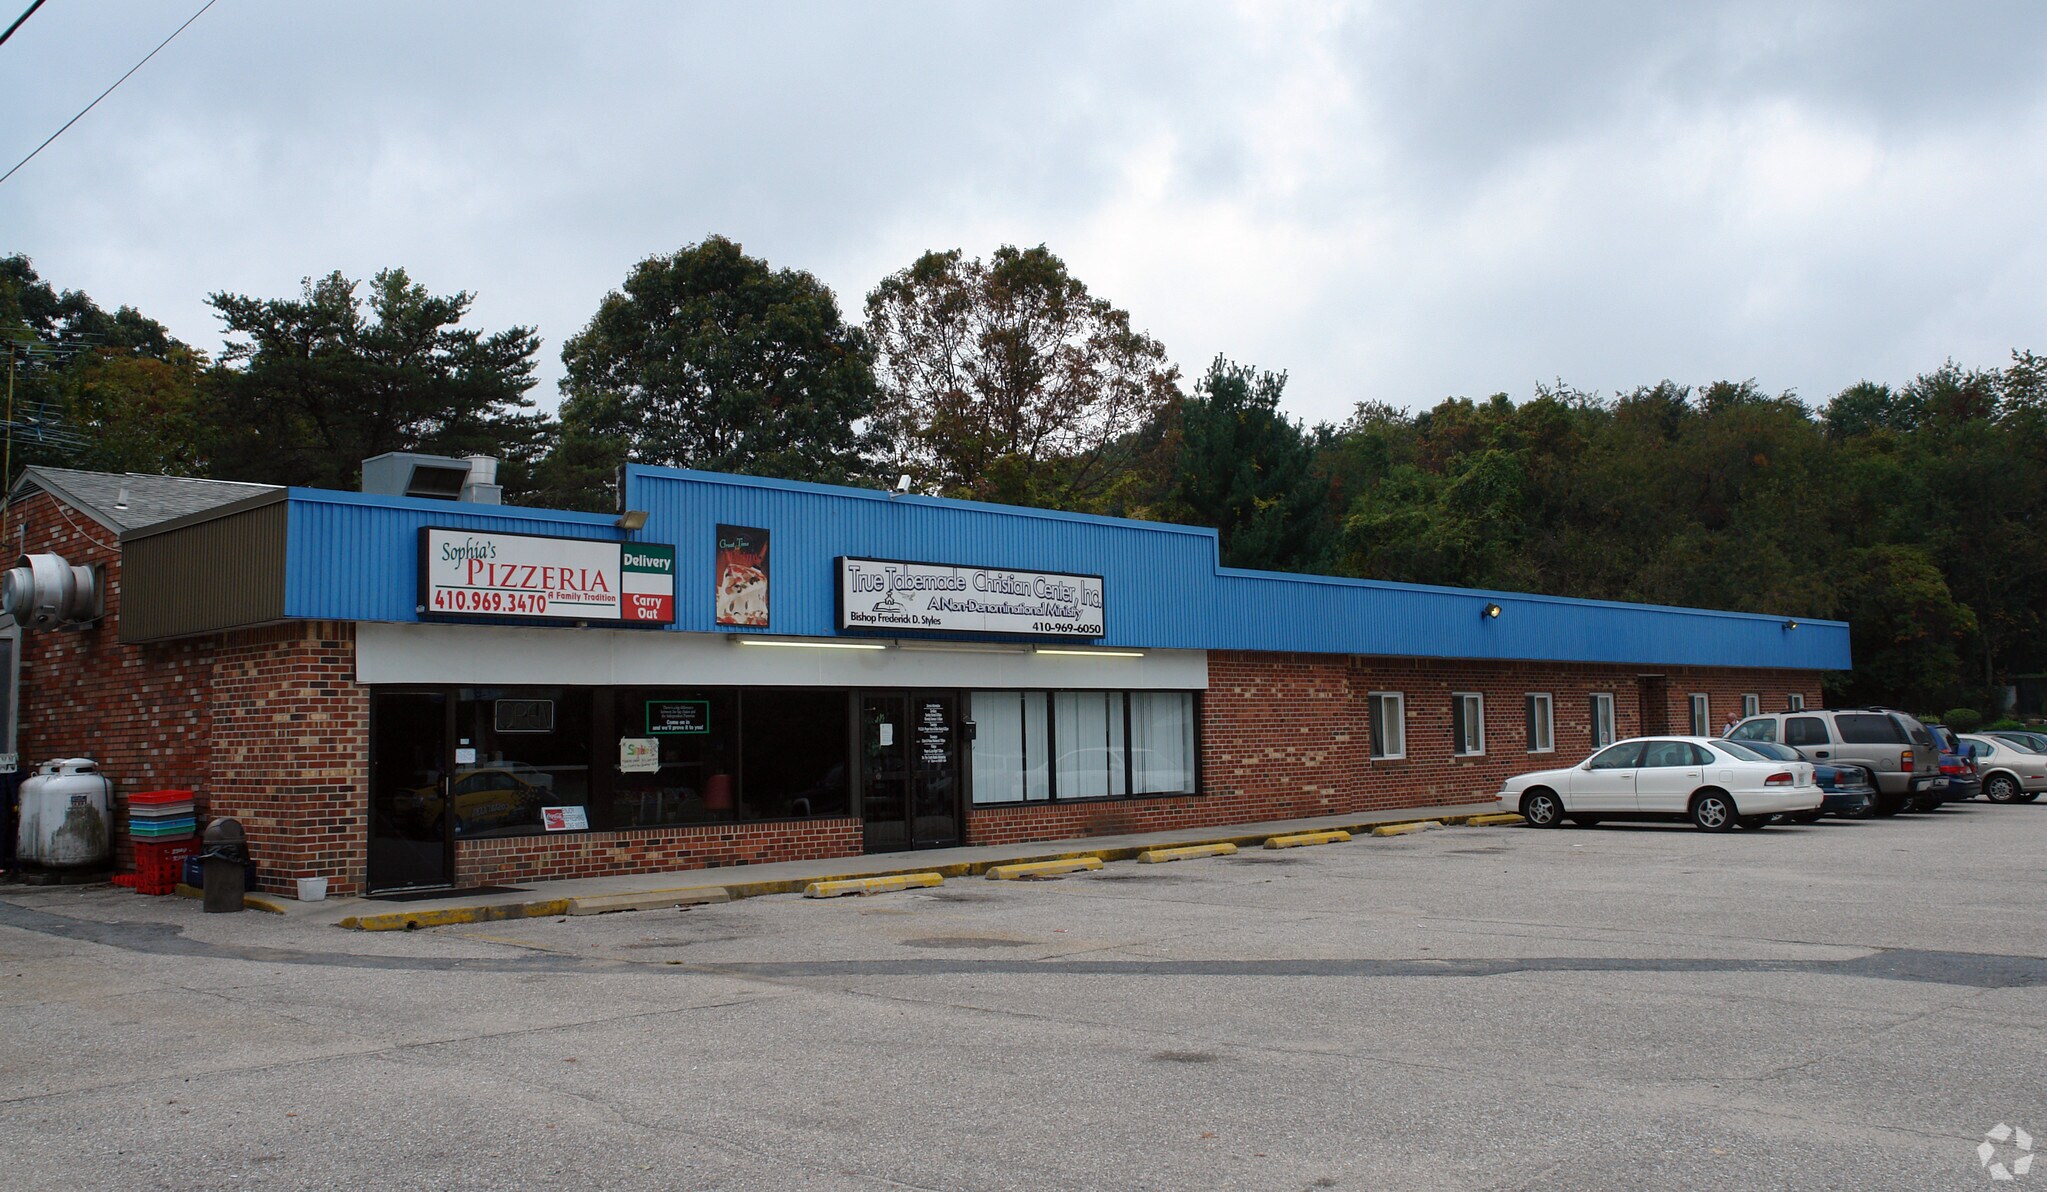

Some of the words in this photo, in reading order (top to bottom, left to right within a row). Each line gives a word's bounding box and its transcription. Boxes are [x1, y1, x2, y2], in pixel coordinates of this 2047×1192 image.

[442, 537, 496, 570] Sophia's
[624, 553, 671, 570] Delivery
[465, 558, 610, 592] PIZZERIA
[848, 565, 884, 592] True
[972, 570, 1031, 596] Christian
[1033, 575, 1079, 608] Center,
[1080, 580, 1102, 608] Inc.
[435, 589, 546, 613] 410.969.3470
[548, 591, 554, 599] A
[556, 592, 581, 602] Family
[583, 592, 616, 602] Tradition
[632, 594, 662, 609] Carry
[637, 608, 658, 619] Out
[927, 596, 940, 610] A
[1046, 602, 1083, 621] Ministry
[851, 611, 876, 624] Bishop
[878, 613, 910, 624] Frederick
[912, 615, 920, 624] D.
[921, 615, 941, 626] Styles
[1032, 621, 1101, 634] 410-969-6050
